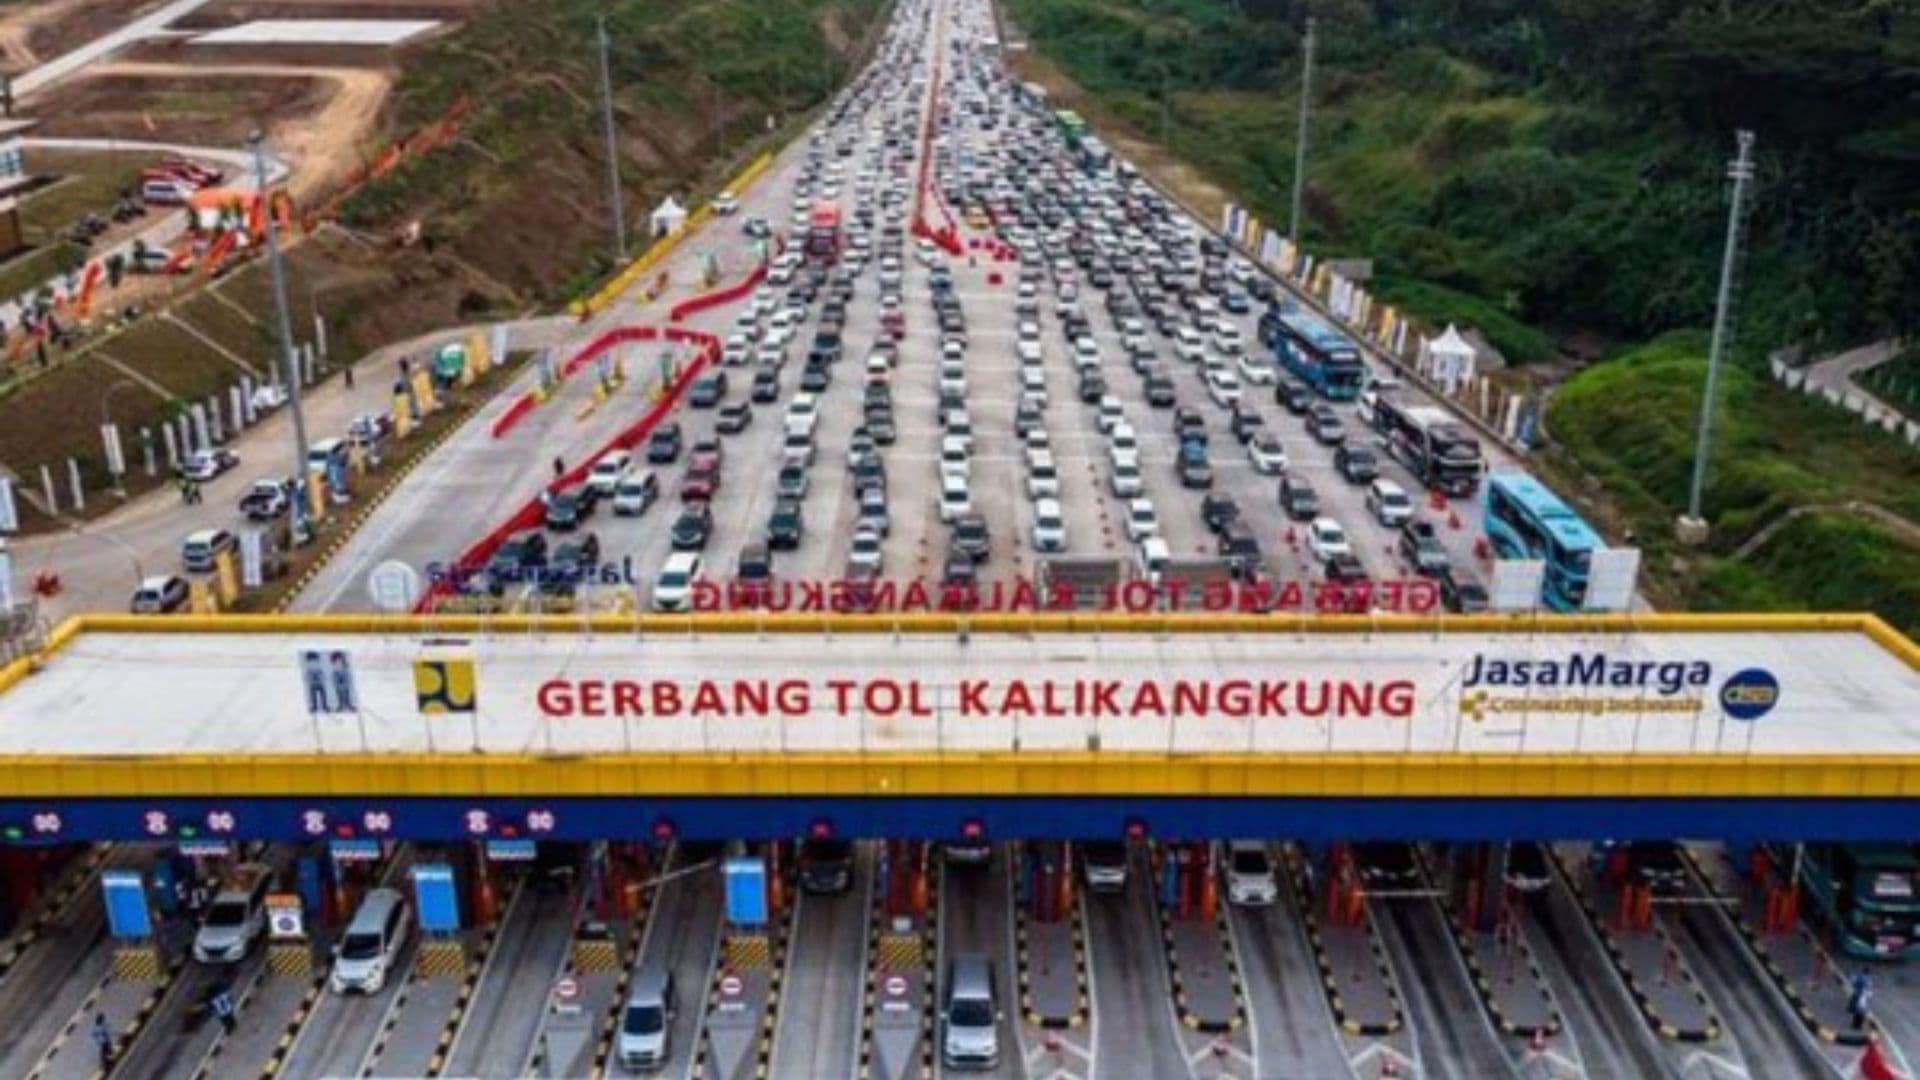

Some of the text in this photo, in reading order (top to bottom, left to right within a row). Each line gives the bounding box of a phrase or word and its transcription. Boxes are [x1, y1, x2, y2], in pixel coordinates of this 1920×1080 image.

[537, 680, 1417, 717] GERBANG TOL KALIKANGKUNG
